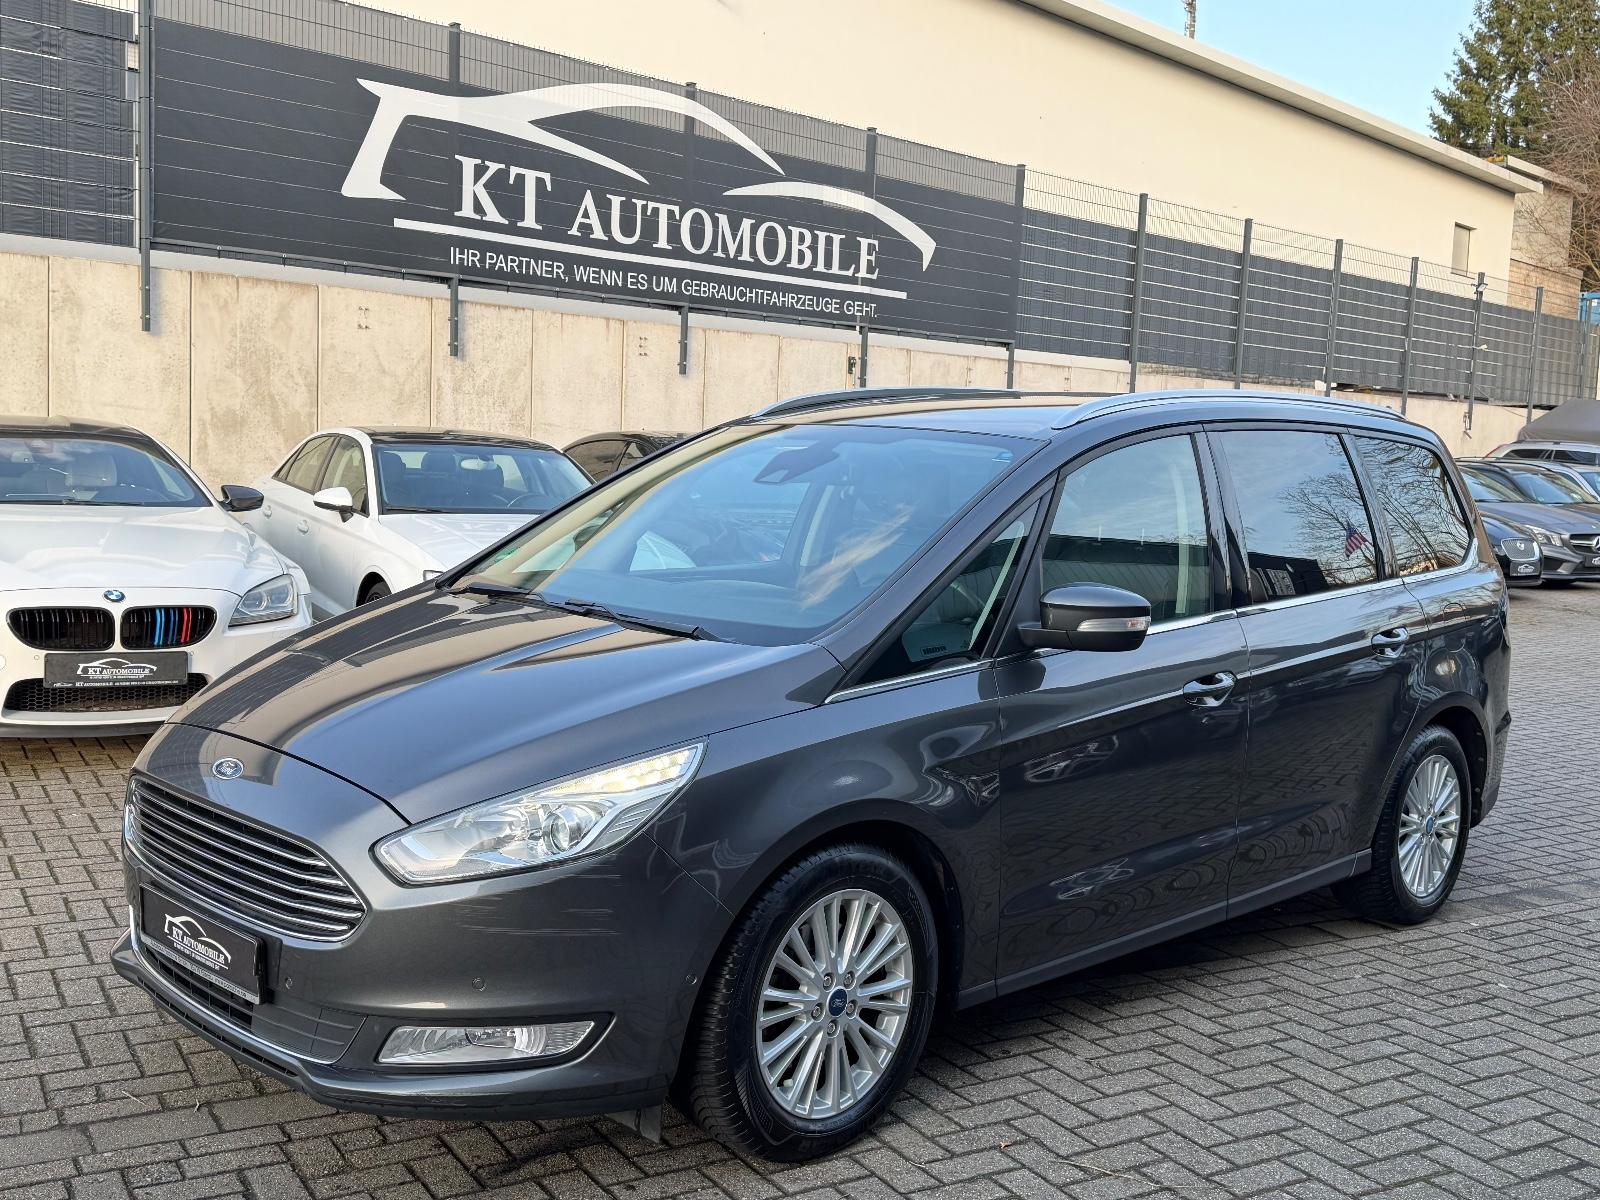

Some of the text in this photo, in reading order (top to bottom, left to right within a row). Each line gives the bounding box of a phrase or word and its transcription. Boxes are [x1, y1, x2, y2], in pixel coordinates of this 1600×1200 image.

[454, 154, 880, 280] KT AUTOMOBILE
[450, 246, 879, 318] IHR PARTNER, WENN ES UM GEBRAUCHTFAHRZEUGE GEHT.
[88, 667, 102, 675] KT
[172, 926, 183, 942] KT
[183, 935, 225, 964] AUTOMOBILE
